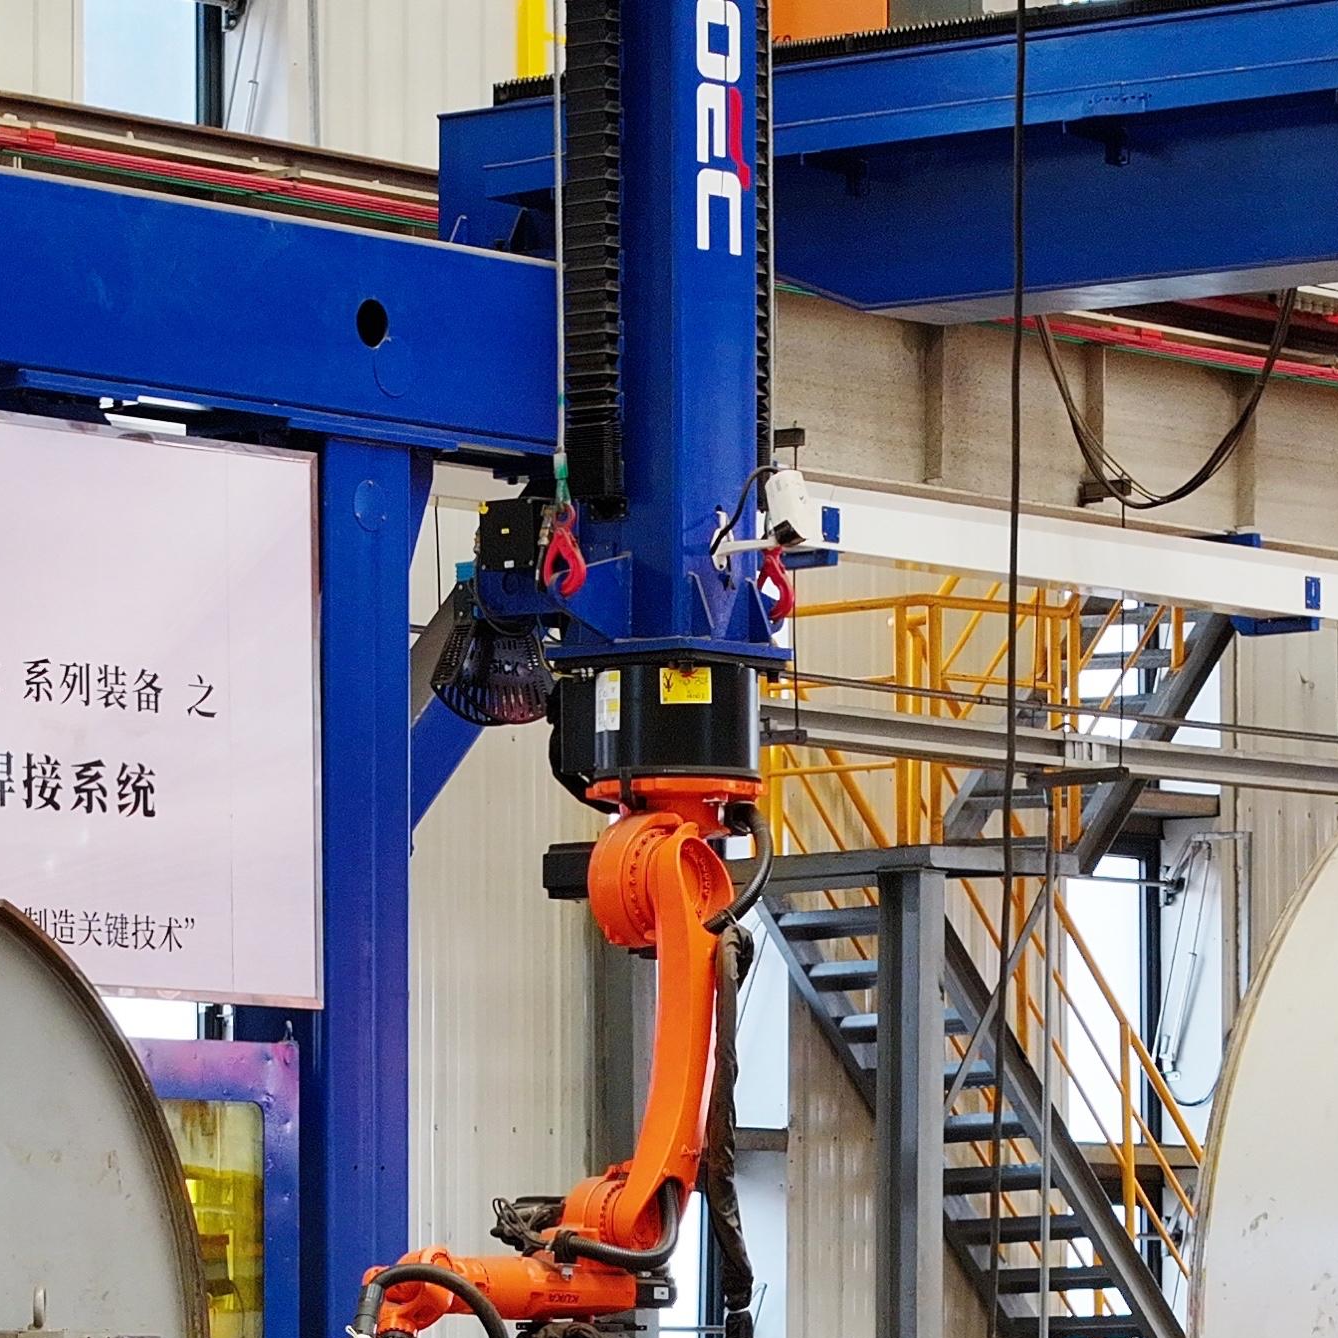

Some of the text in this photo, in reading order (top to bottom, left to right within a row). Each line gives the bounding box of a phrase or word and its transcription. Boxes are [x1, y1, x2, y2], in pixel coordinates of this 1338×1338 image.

[23, 658, 163, 714] 系列装备
[187, 674, 218, 719] 之
